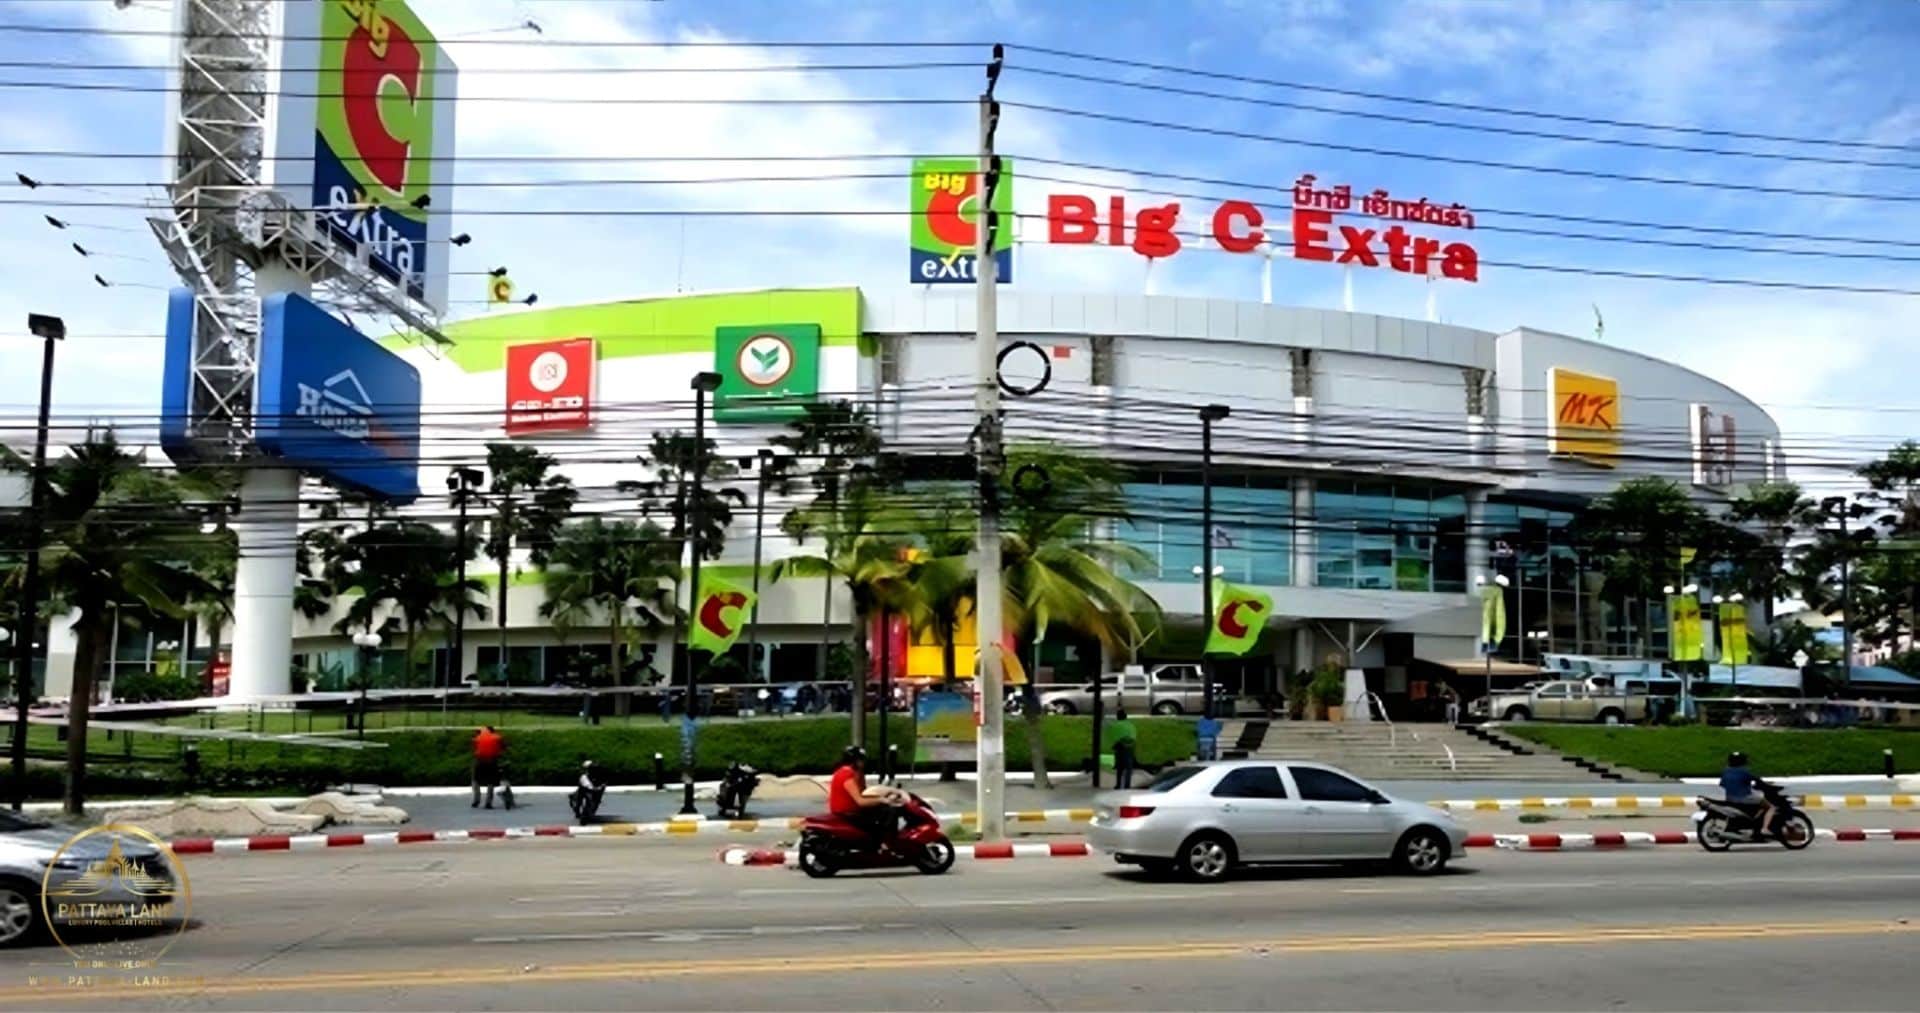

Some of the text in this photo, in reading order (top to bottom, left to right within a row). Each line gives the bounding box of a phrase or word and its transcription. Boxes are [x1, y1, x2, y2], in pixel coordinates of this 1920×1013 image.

[1213, 200, 1264, 253] C
[1293, 208, 1478, 282] Extra
[921, 256, 1000, 279] ext
[1559, 391, 1614, 431] MK
